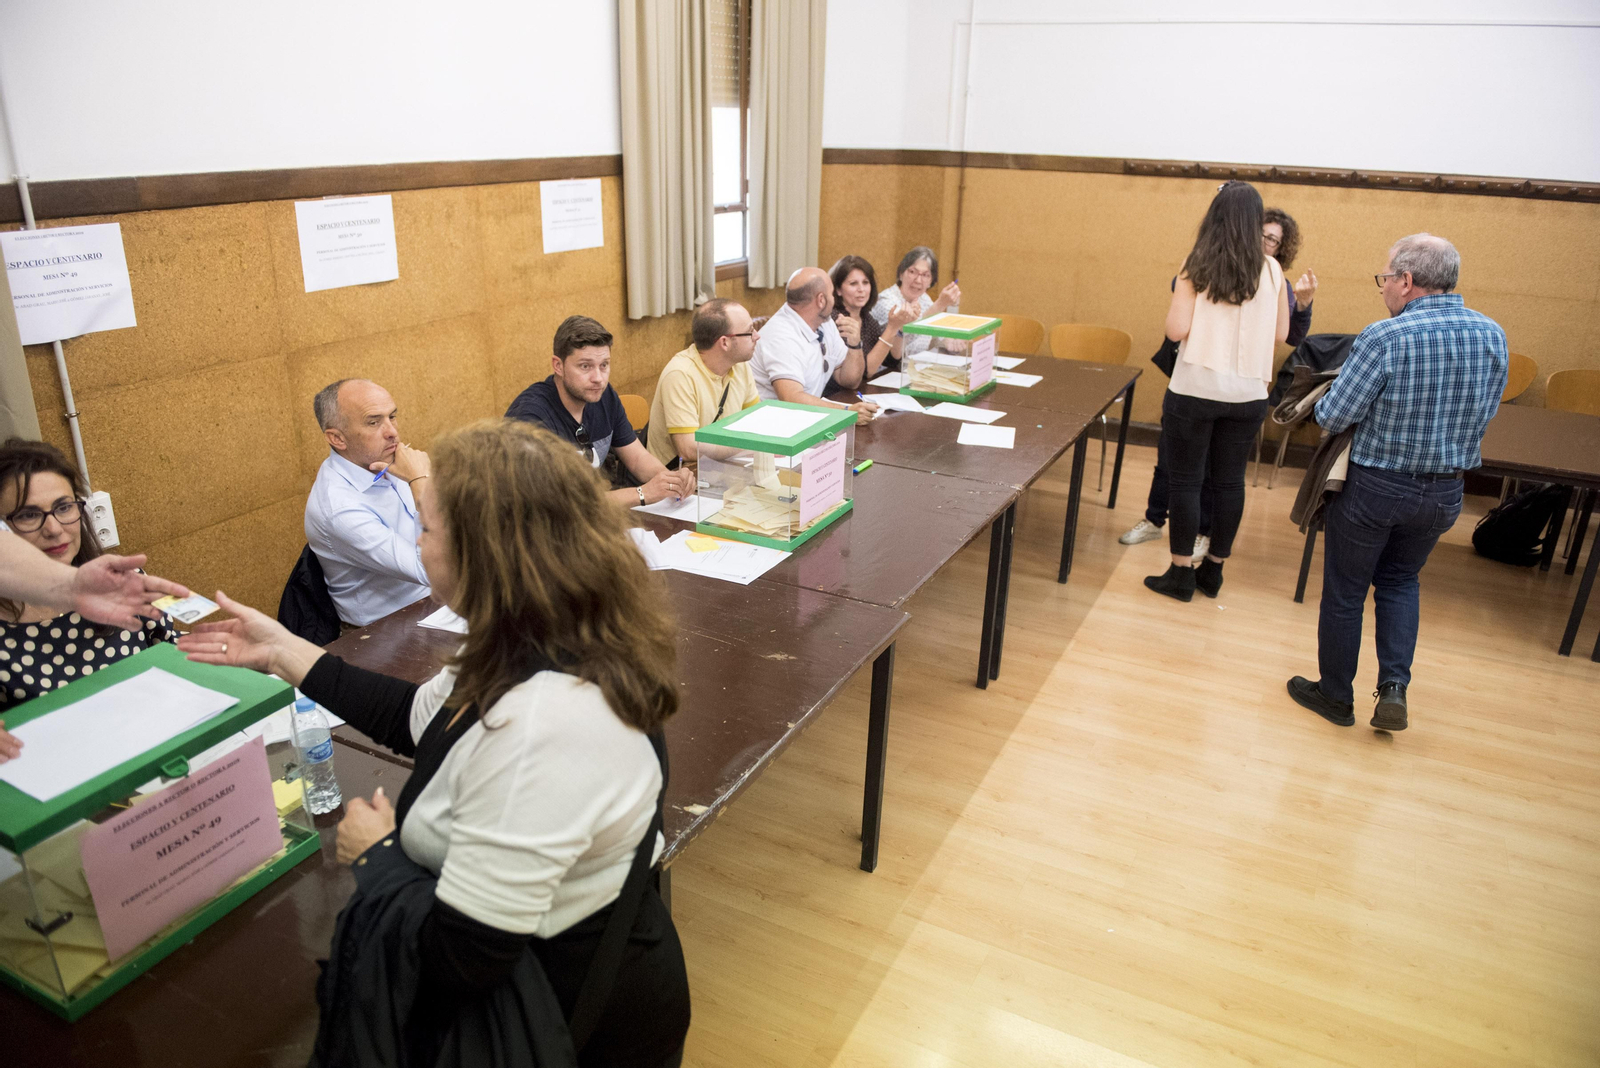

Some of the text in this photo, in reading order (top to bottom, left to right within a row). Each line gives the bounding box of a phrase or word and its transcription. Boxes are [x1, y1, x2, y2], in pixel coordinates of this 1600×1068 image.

[52, 252, 102, 264] CENTENARIO
[130, 822, 170, 850] ESPACIO
[180, 784, 235, 821] CENTENARIO
[156, 816, 222, 860] MESA Nº 49
